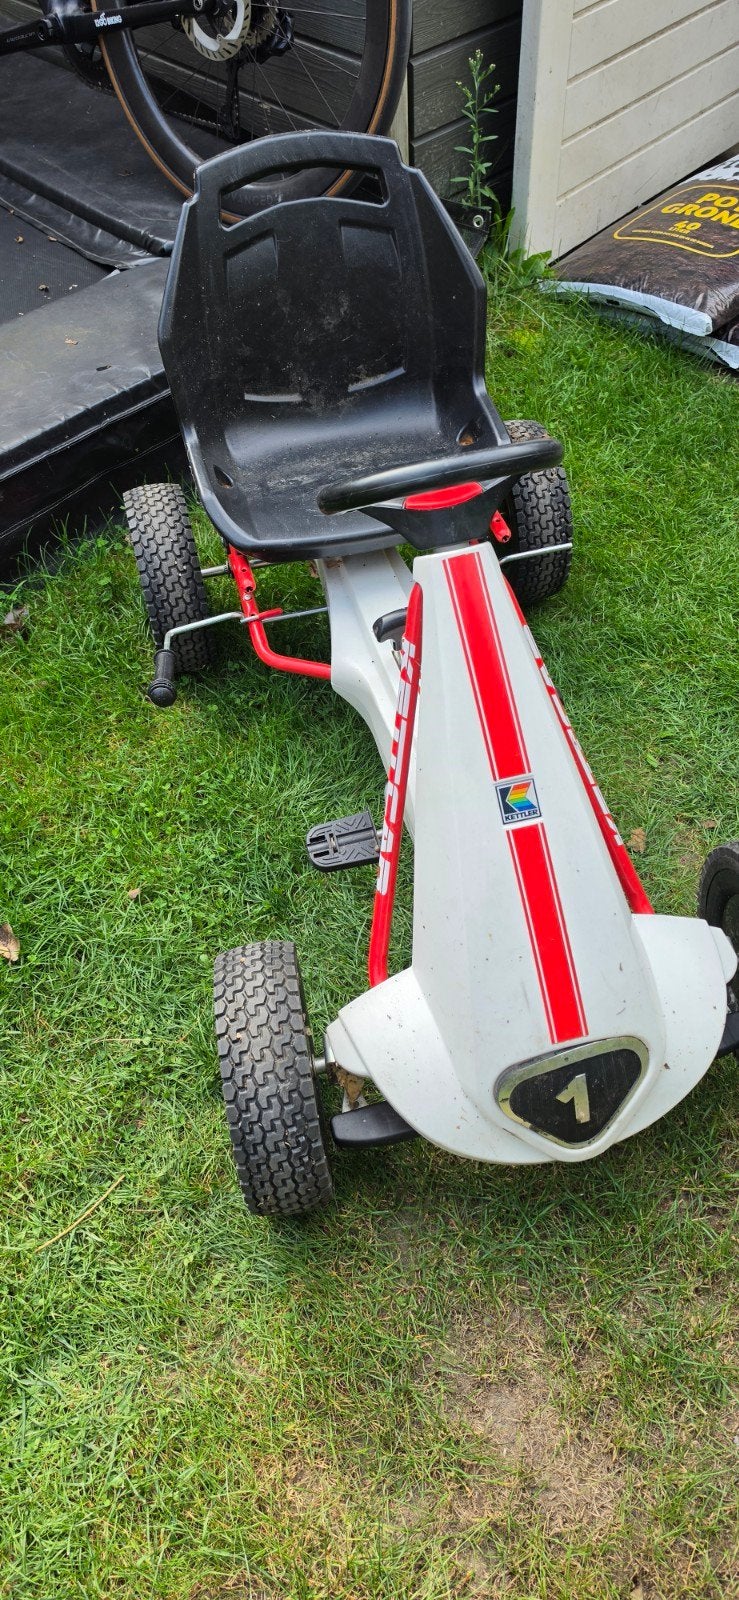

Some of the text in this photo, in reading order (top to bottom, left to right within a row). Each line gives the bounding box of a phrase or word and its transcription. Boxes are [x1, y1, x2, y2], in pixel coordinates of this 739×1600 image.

[376, 634, 416, 896] KETTCAR
[504, 809, 538, 821] KETTLER
[555, 1073, 591, 1124] 1
